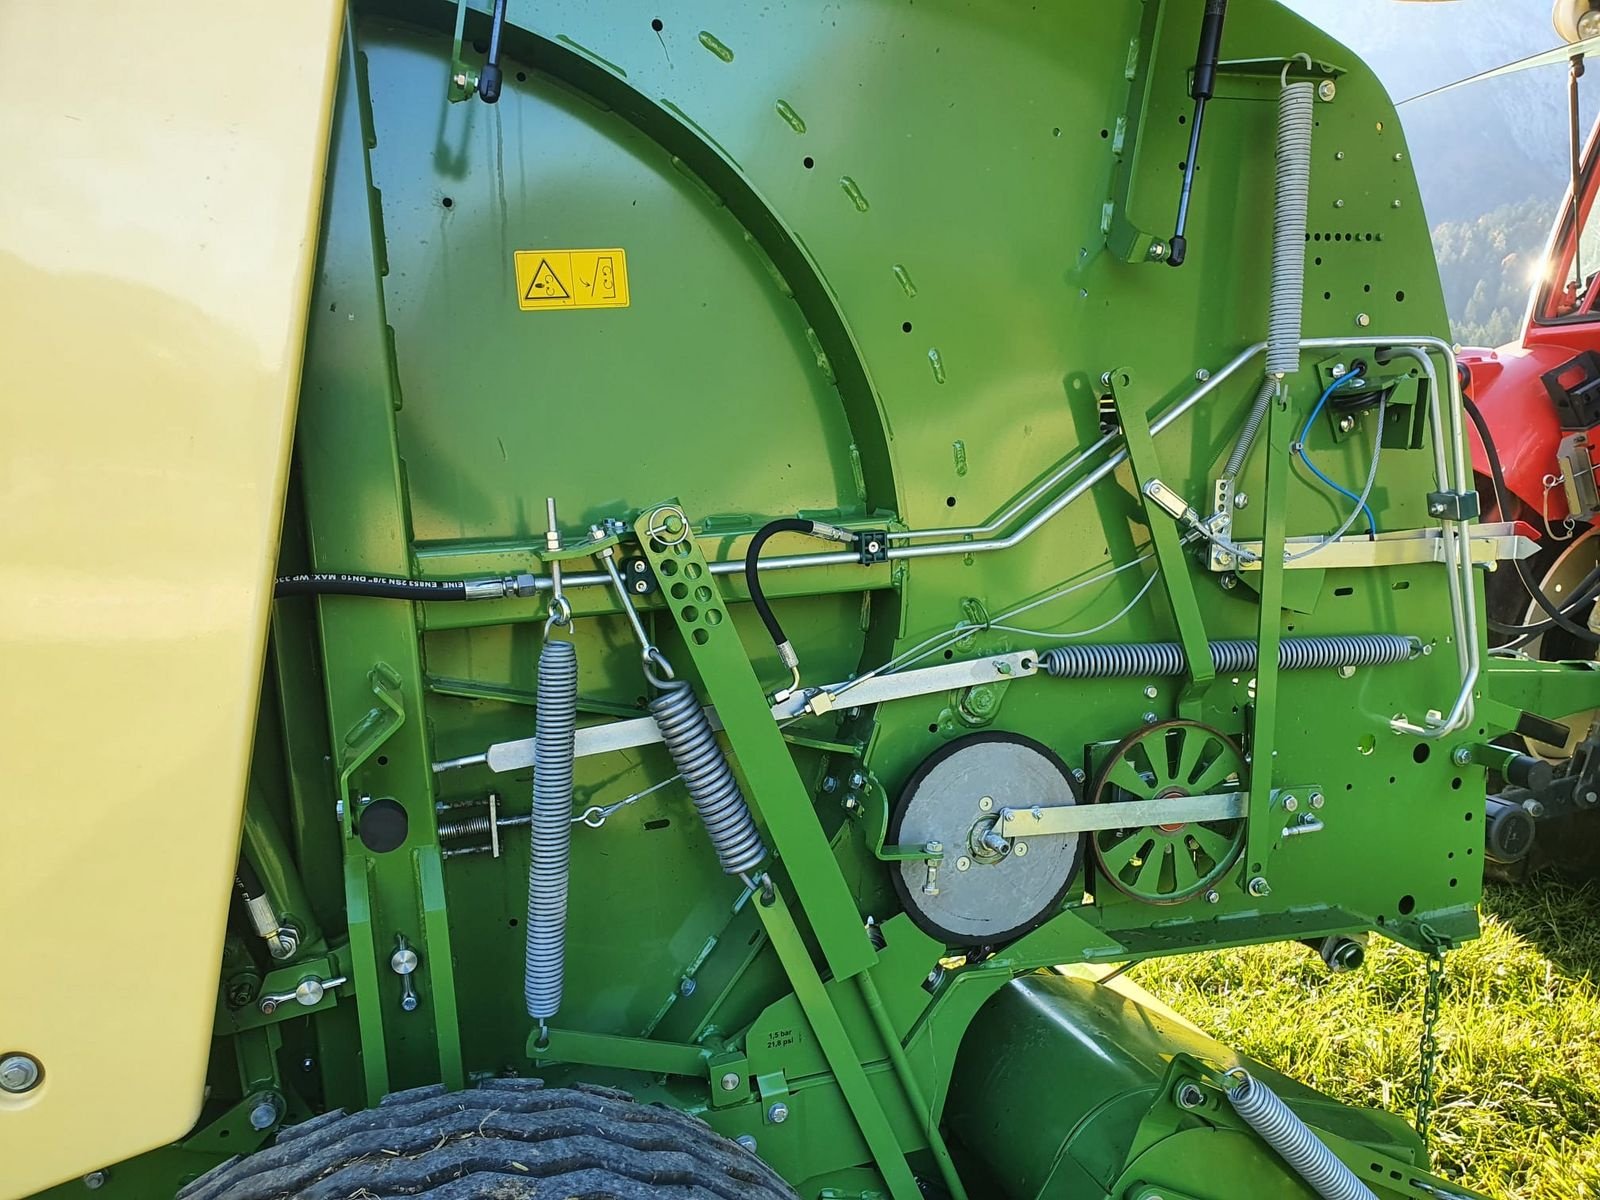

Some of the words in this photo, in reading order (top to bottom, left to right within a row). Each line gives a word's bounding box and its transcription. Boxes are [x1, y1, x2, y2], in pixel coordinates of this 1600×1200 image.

[341, 574, 366, 582] DN10
[388, 578, 407, 586] 2SN
[409, 580, 437, 588] EN853
[769, 1032, 779, 1040] 1,5
[783, 1036, 794, 1047] psi
